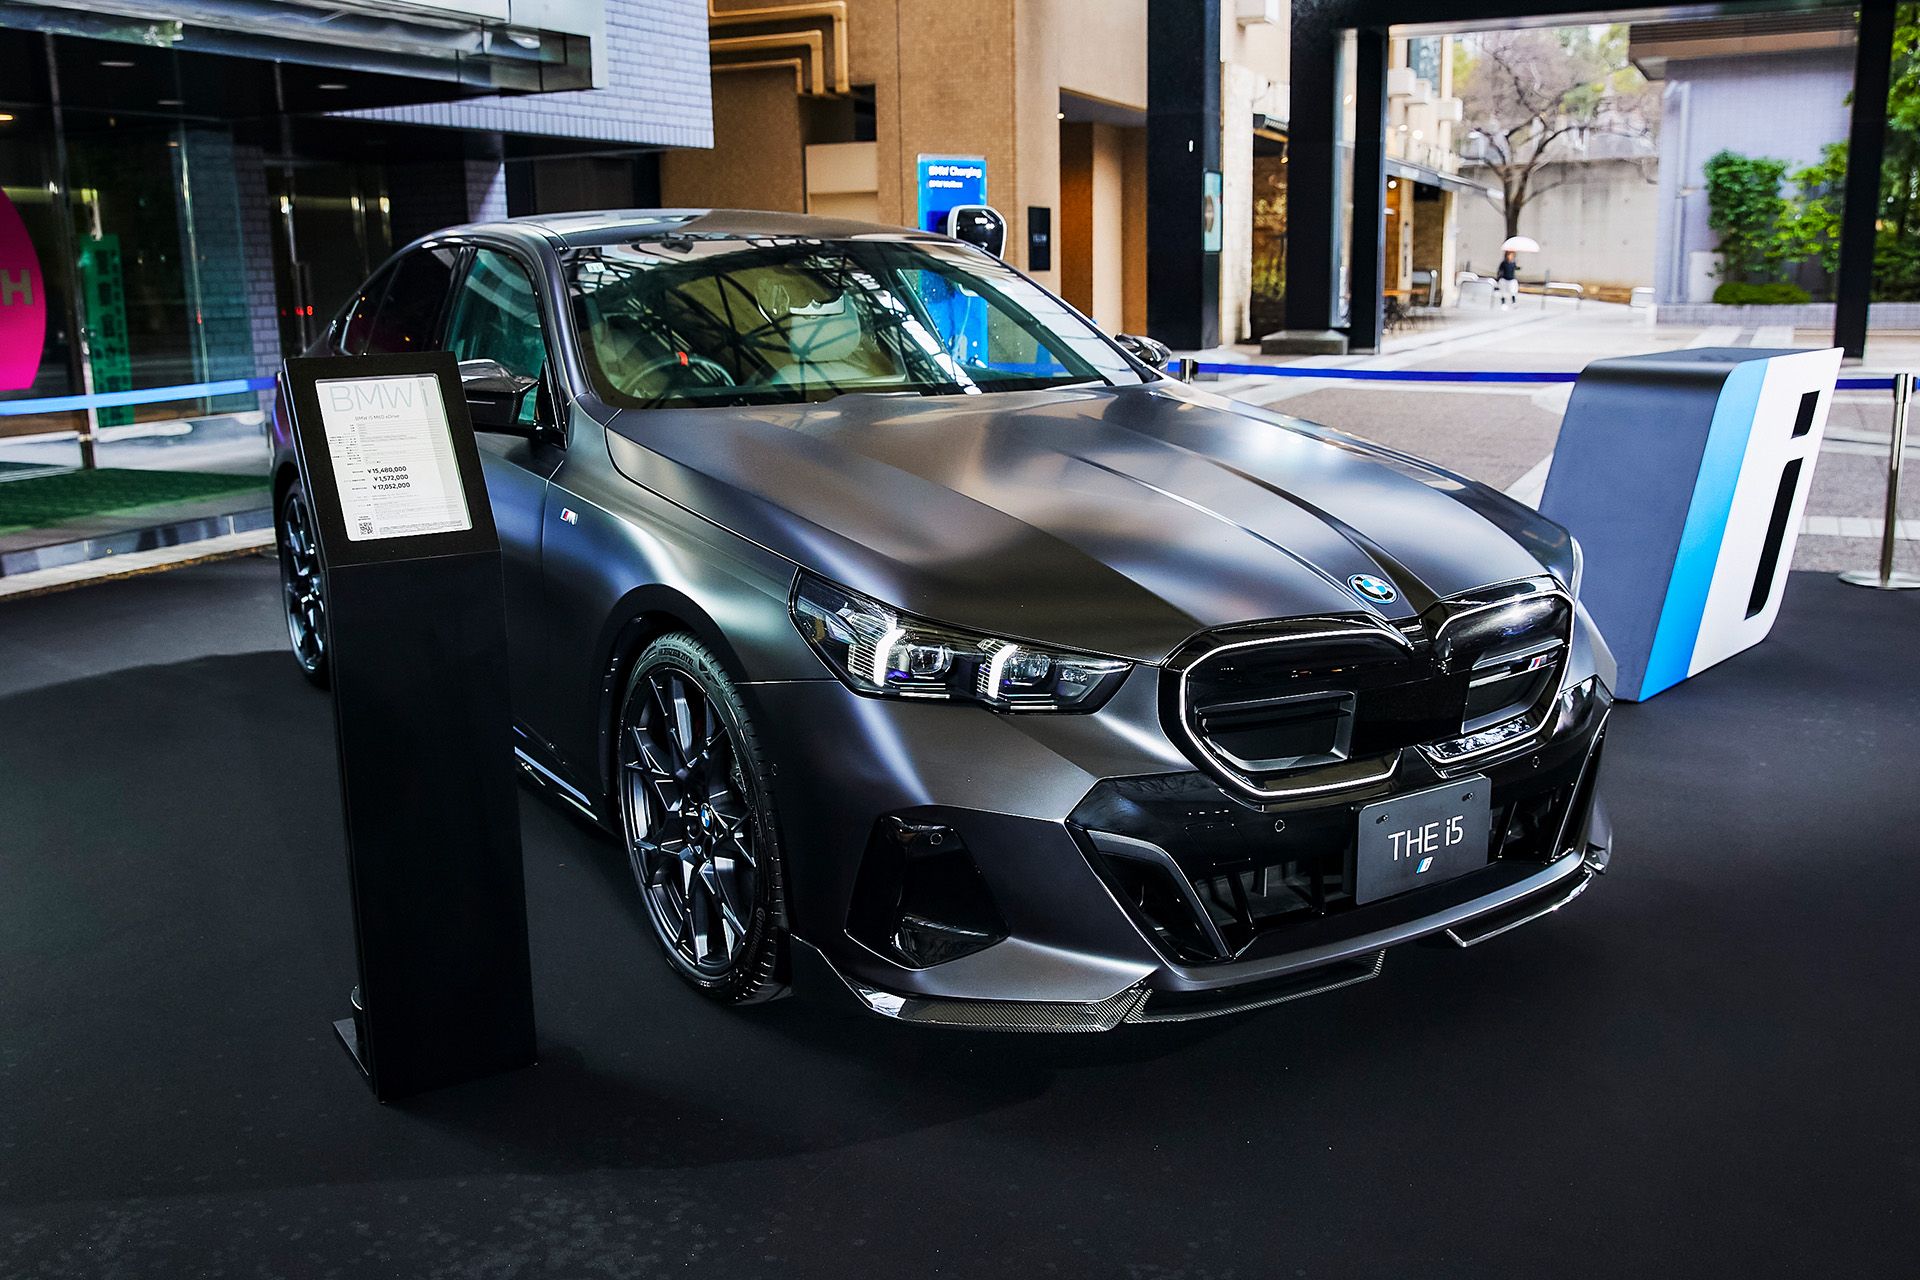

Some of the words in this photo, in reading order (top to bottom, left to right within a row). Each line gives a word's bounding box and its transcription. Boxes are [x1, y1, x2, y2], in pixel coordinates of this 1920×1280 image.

[329, 383, 412, 412] BMW
[1388, 822, 1439, 861] THE
[1445, 815, 1464, 846] i5
